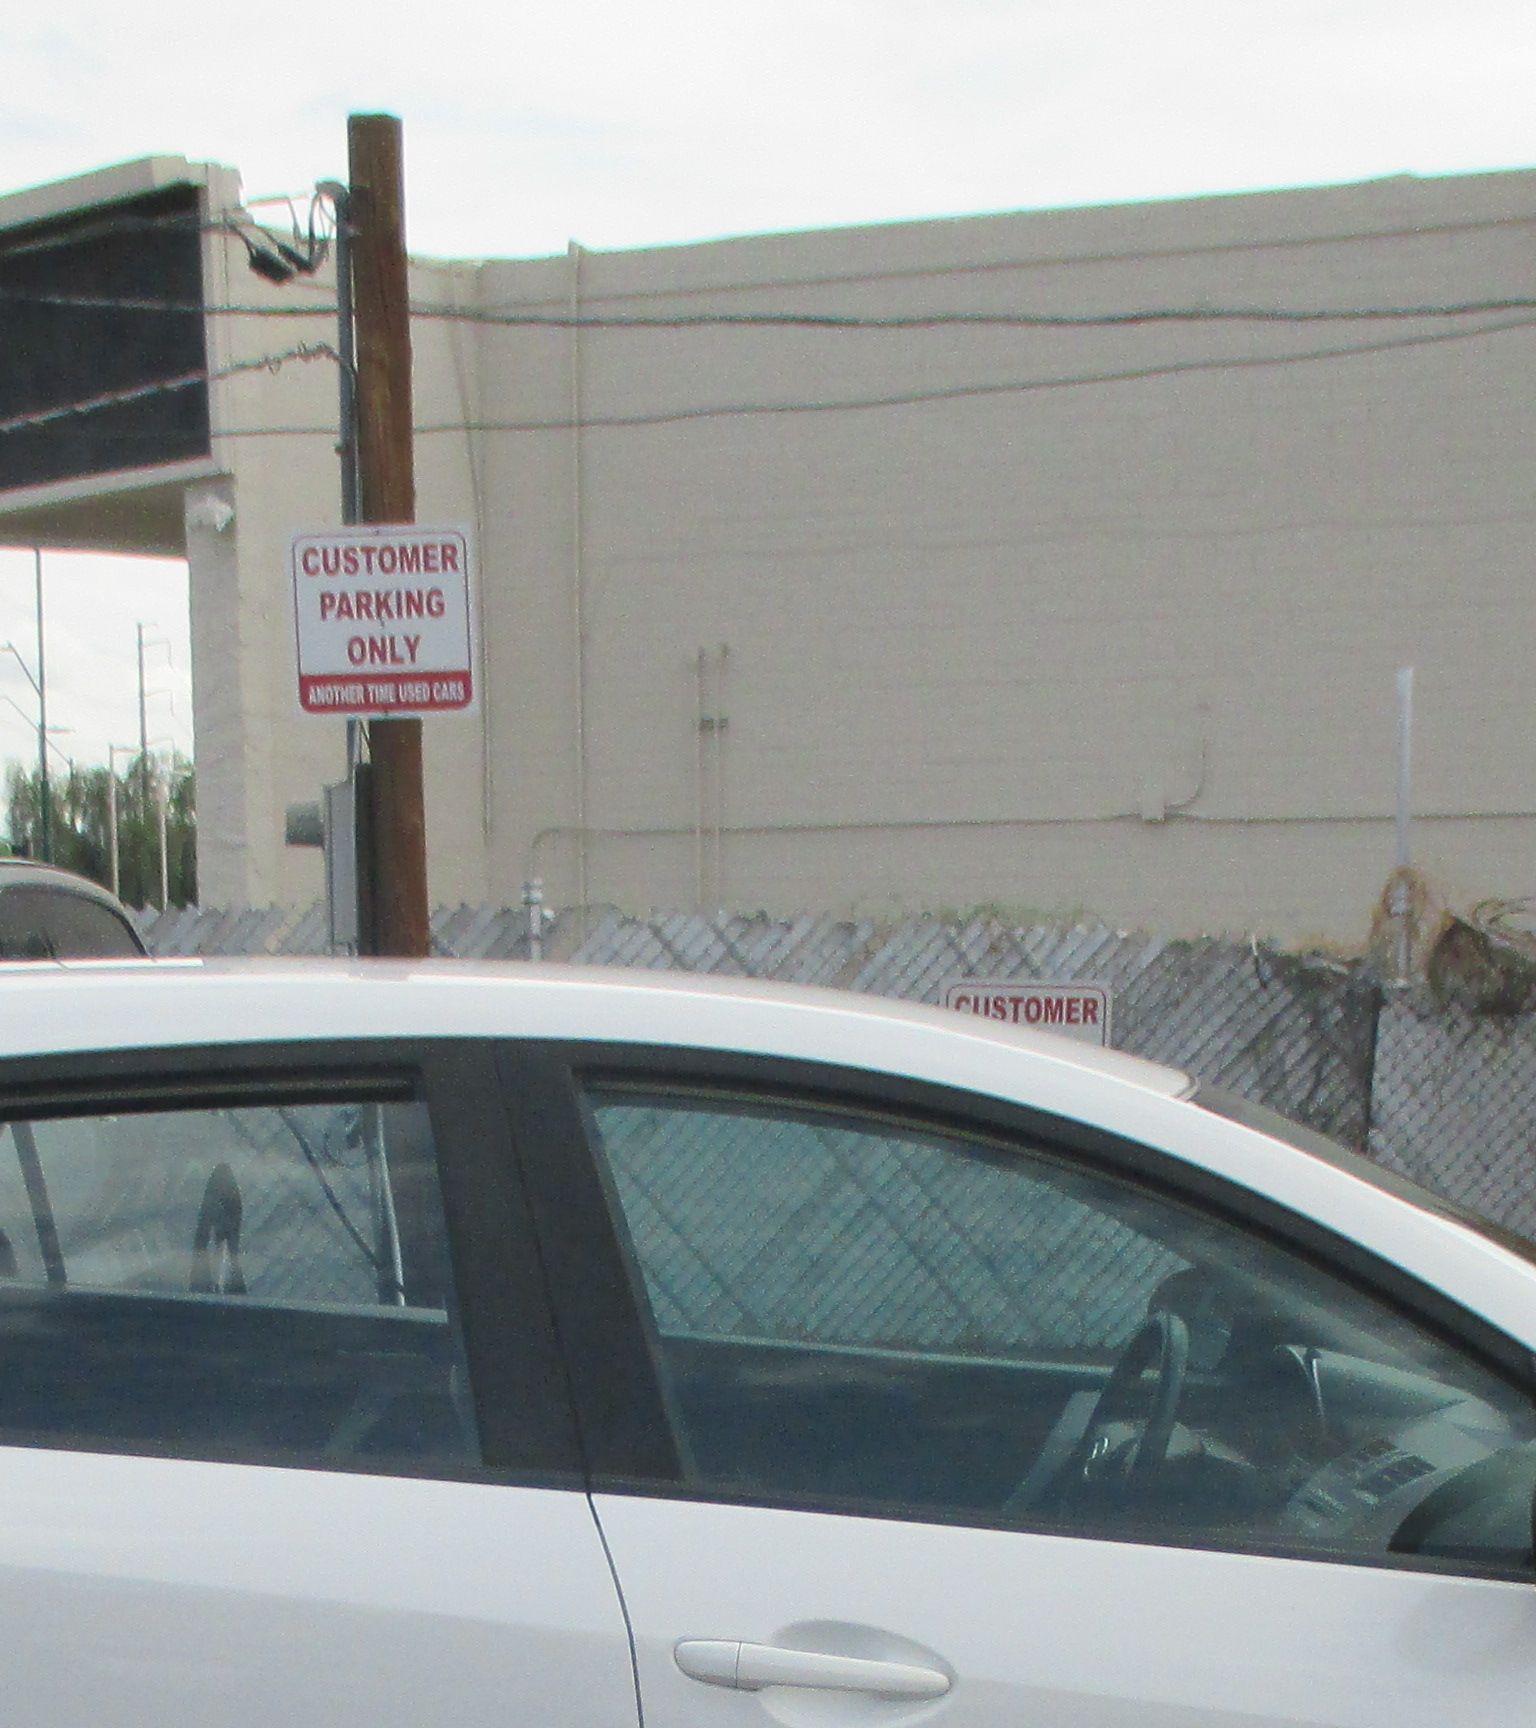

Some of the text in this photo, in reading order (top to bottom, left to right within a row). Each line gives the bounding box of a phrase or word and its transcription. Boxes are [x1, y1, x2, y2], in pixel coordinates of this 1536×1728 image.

[302, 543, 459, 576] CUSTOMER
[320, 588, 445, 621] PARKING
[347, 634, 421, 666] ONLY
[309, 681, 464, 705] ANOTHER TIME USED CARS
